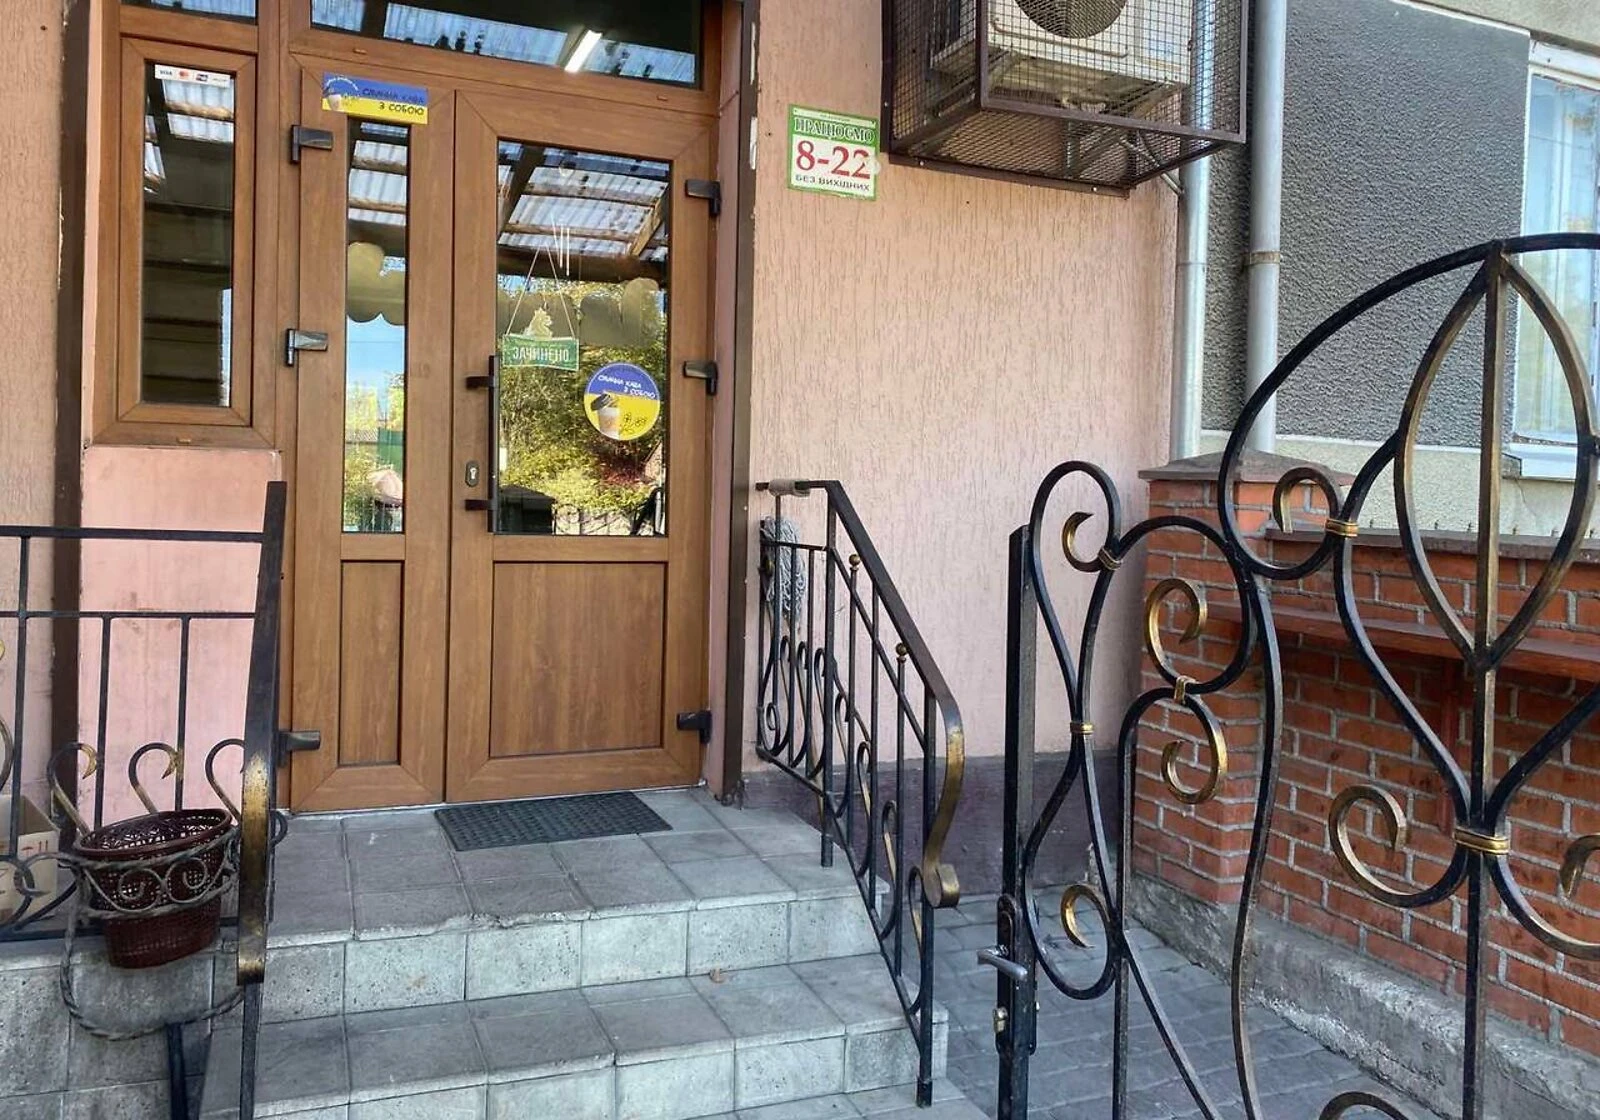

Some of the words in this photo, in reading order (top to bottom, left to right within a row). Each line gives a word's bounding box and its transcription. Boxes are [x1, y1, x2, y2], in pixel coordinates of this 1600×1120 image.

[388, 103, 425, 116] СОБОЮ
[794, 117, 876, 143] ПРАЦЮЄМО
[796, 139, 871, 180] 8-22
[795, 173, 816, 184] БЕЗ
[818, 176, 871, 193] ВИХІДНИХ
[512, 346, 570, 363] ЗАЧИНЕНО
[630, 388, 656, 399] СОБОЮ
